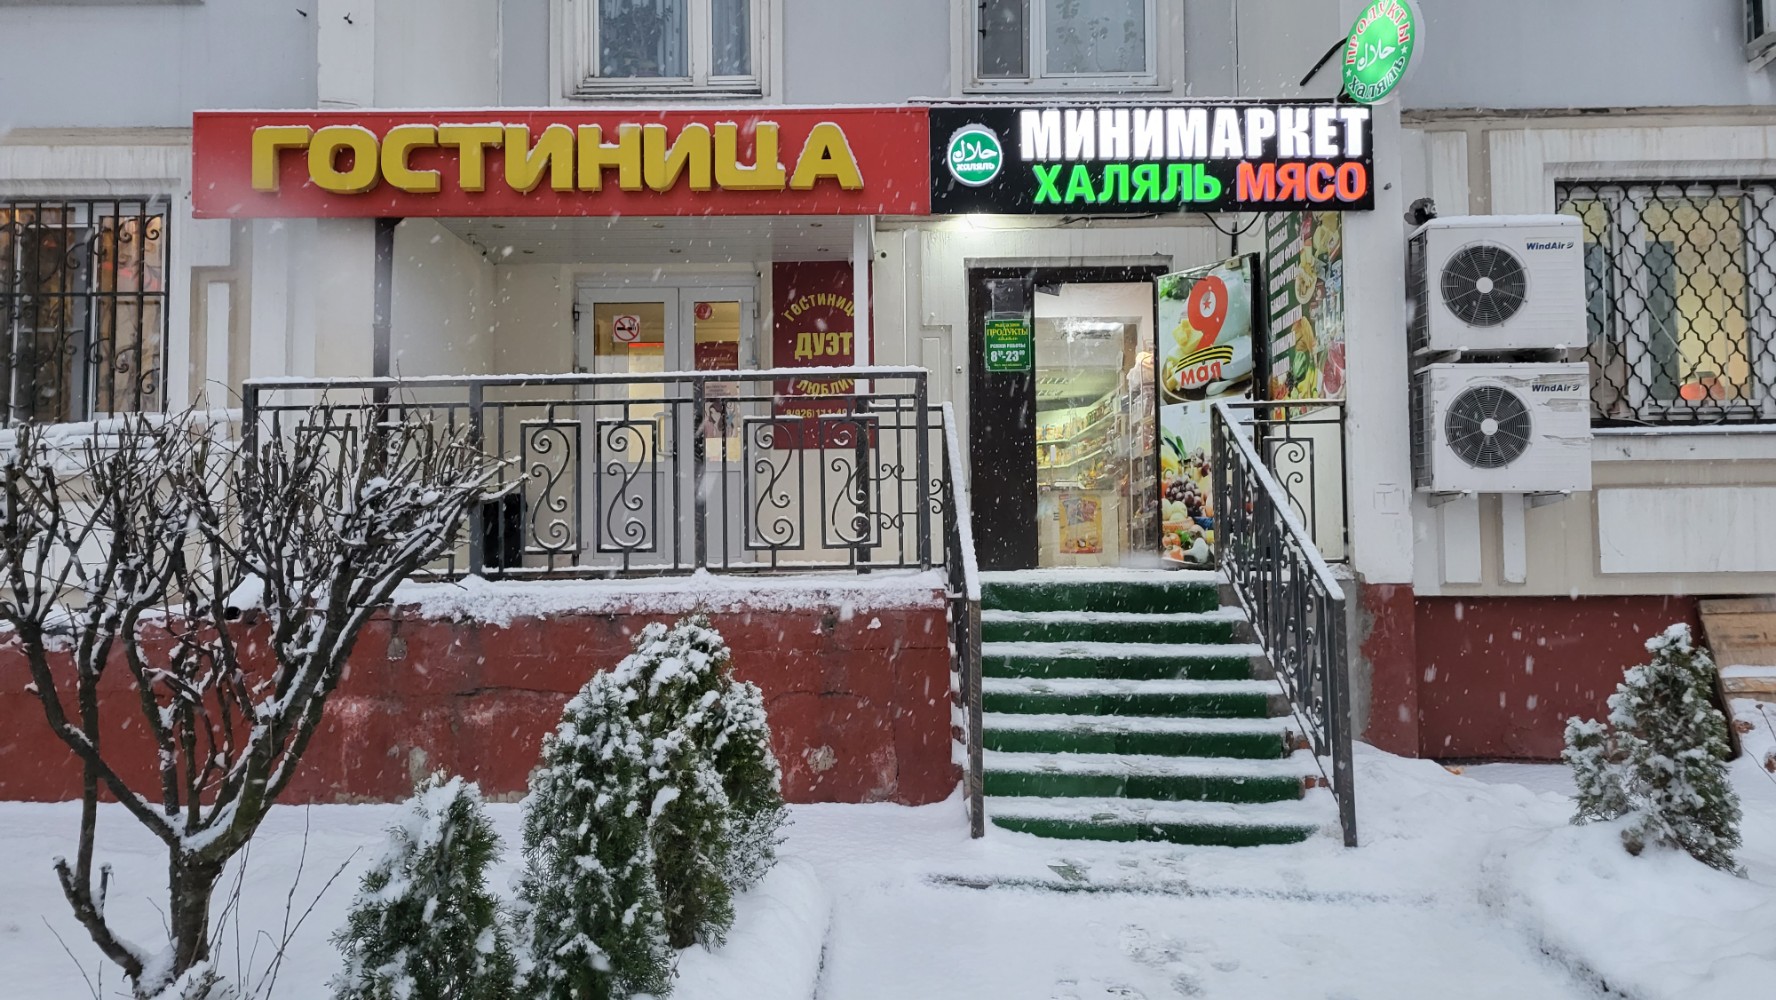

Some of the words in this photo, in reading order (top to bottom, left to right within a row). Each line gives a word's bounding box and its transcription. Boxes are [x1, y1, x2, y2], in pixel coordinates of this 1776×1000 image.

[1019, 107, 1369, 160] МИНИМАРКЕТ
[251, 122, 864, 193] ГОСТИНИЦА
[1032, 163, 1222, 203] ХАЛЯЛЬ
[1236, 162, 1367, 202] МЯСО
[1526, 241, 1566, 250] WindAir
[784, 293, 854, 321] ГОСТИНИЦ
[1187, 275, 1228, 351] 9
[795, 332, 853, 359] ДУЭТ
[987, 328, 1028, 336] ПРОДУКТЫ
[1180, 360, 1222, 388] мая
[1532, 384, 1571, 392] WindAir
